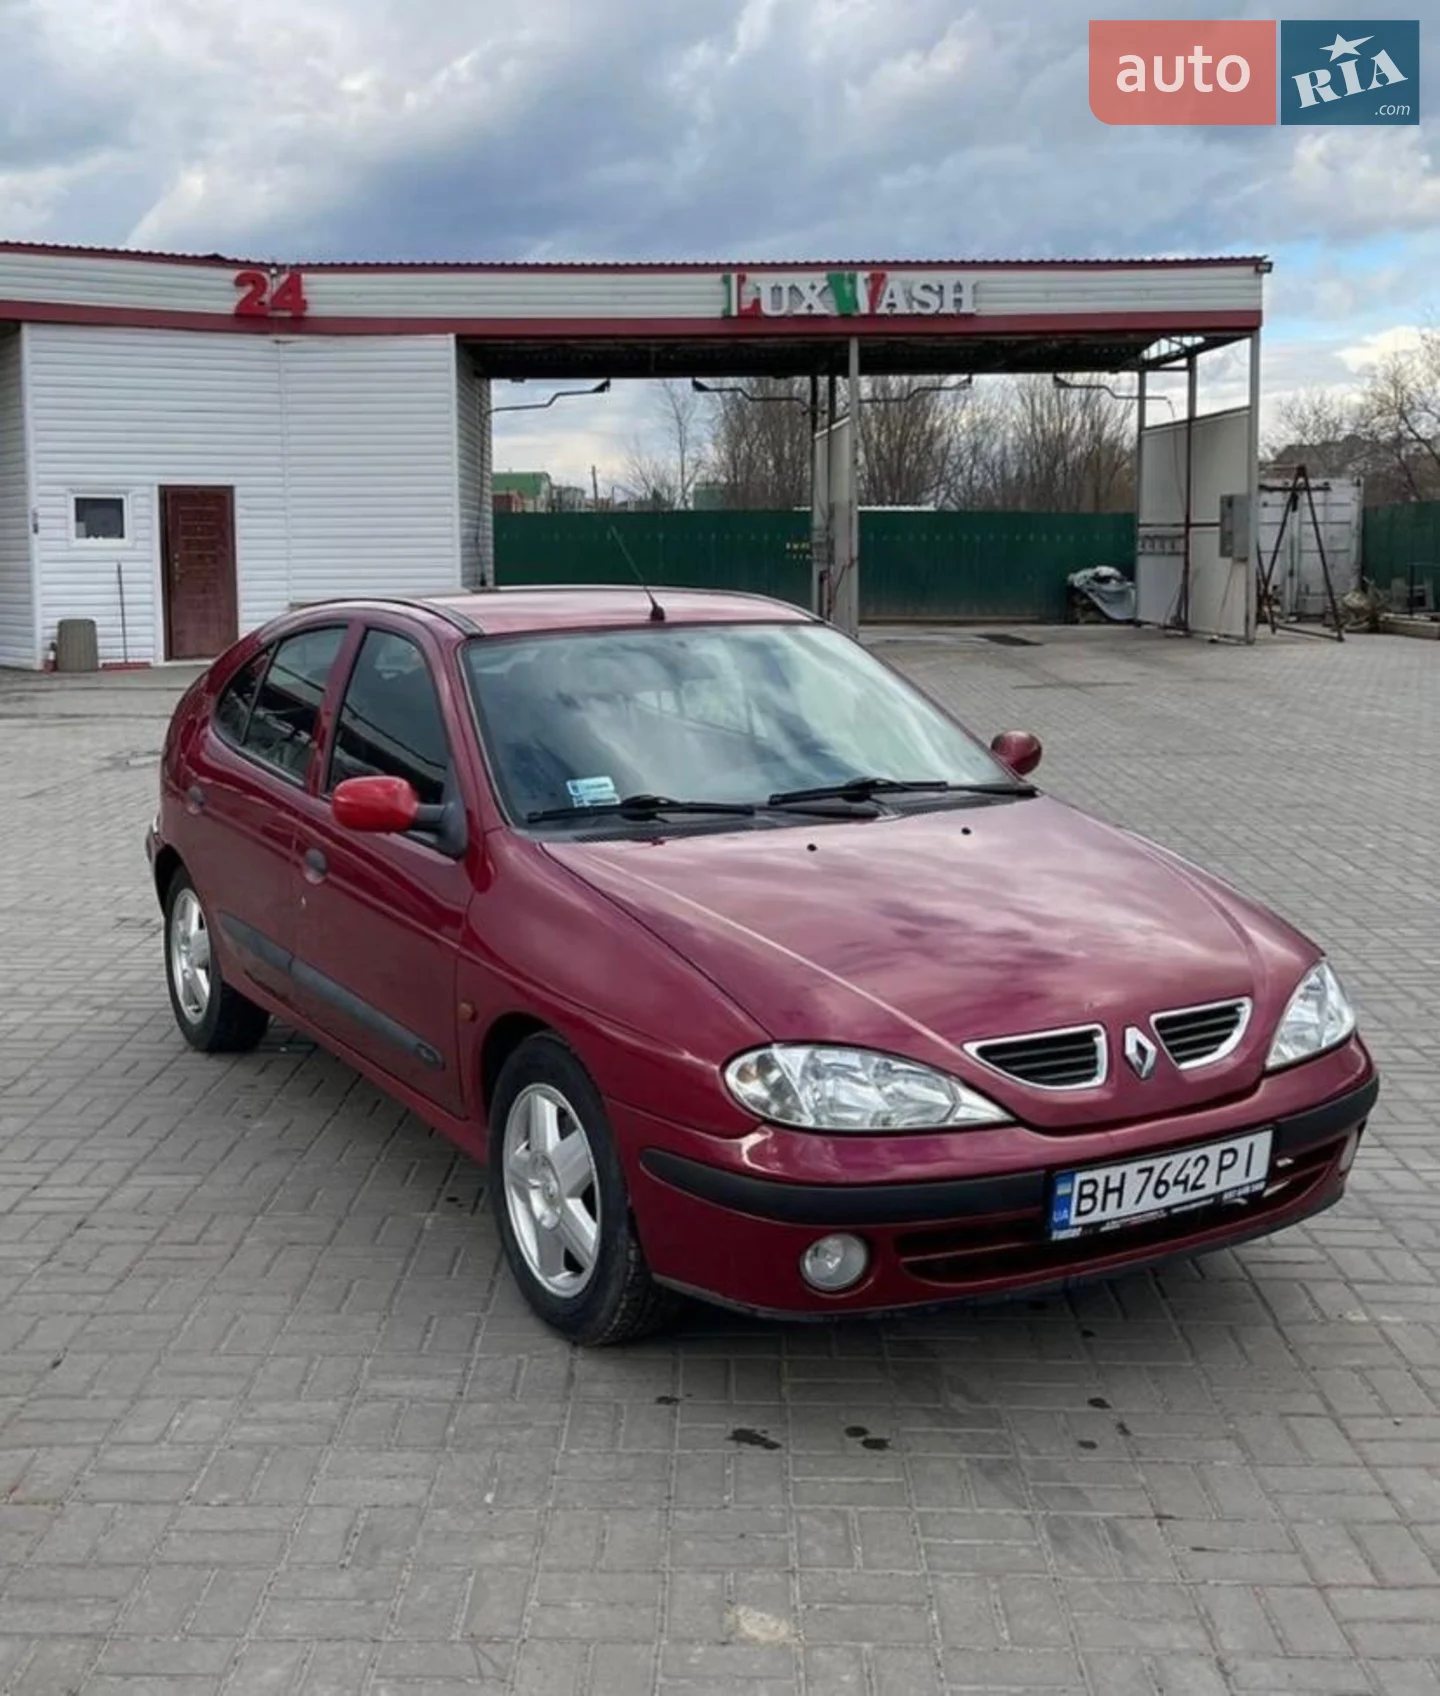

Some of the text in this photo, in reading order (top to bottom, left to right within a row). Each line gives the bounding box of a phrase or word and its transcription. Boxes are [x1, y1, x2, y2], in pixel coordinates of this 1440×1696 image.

[233, 271, 308, 319] 24
[1075, 1171, 1126, 1217] BH
[1134, 1151, 1210, 1206] 7642
